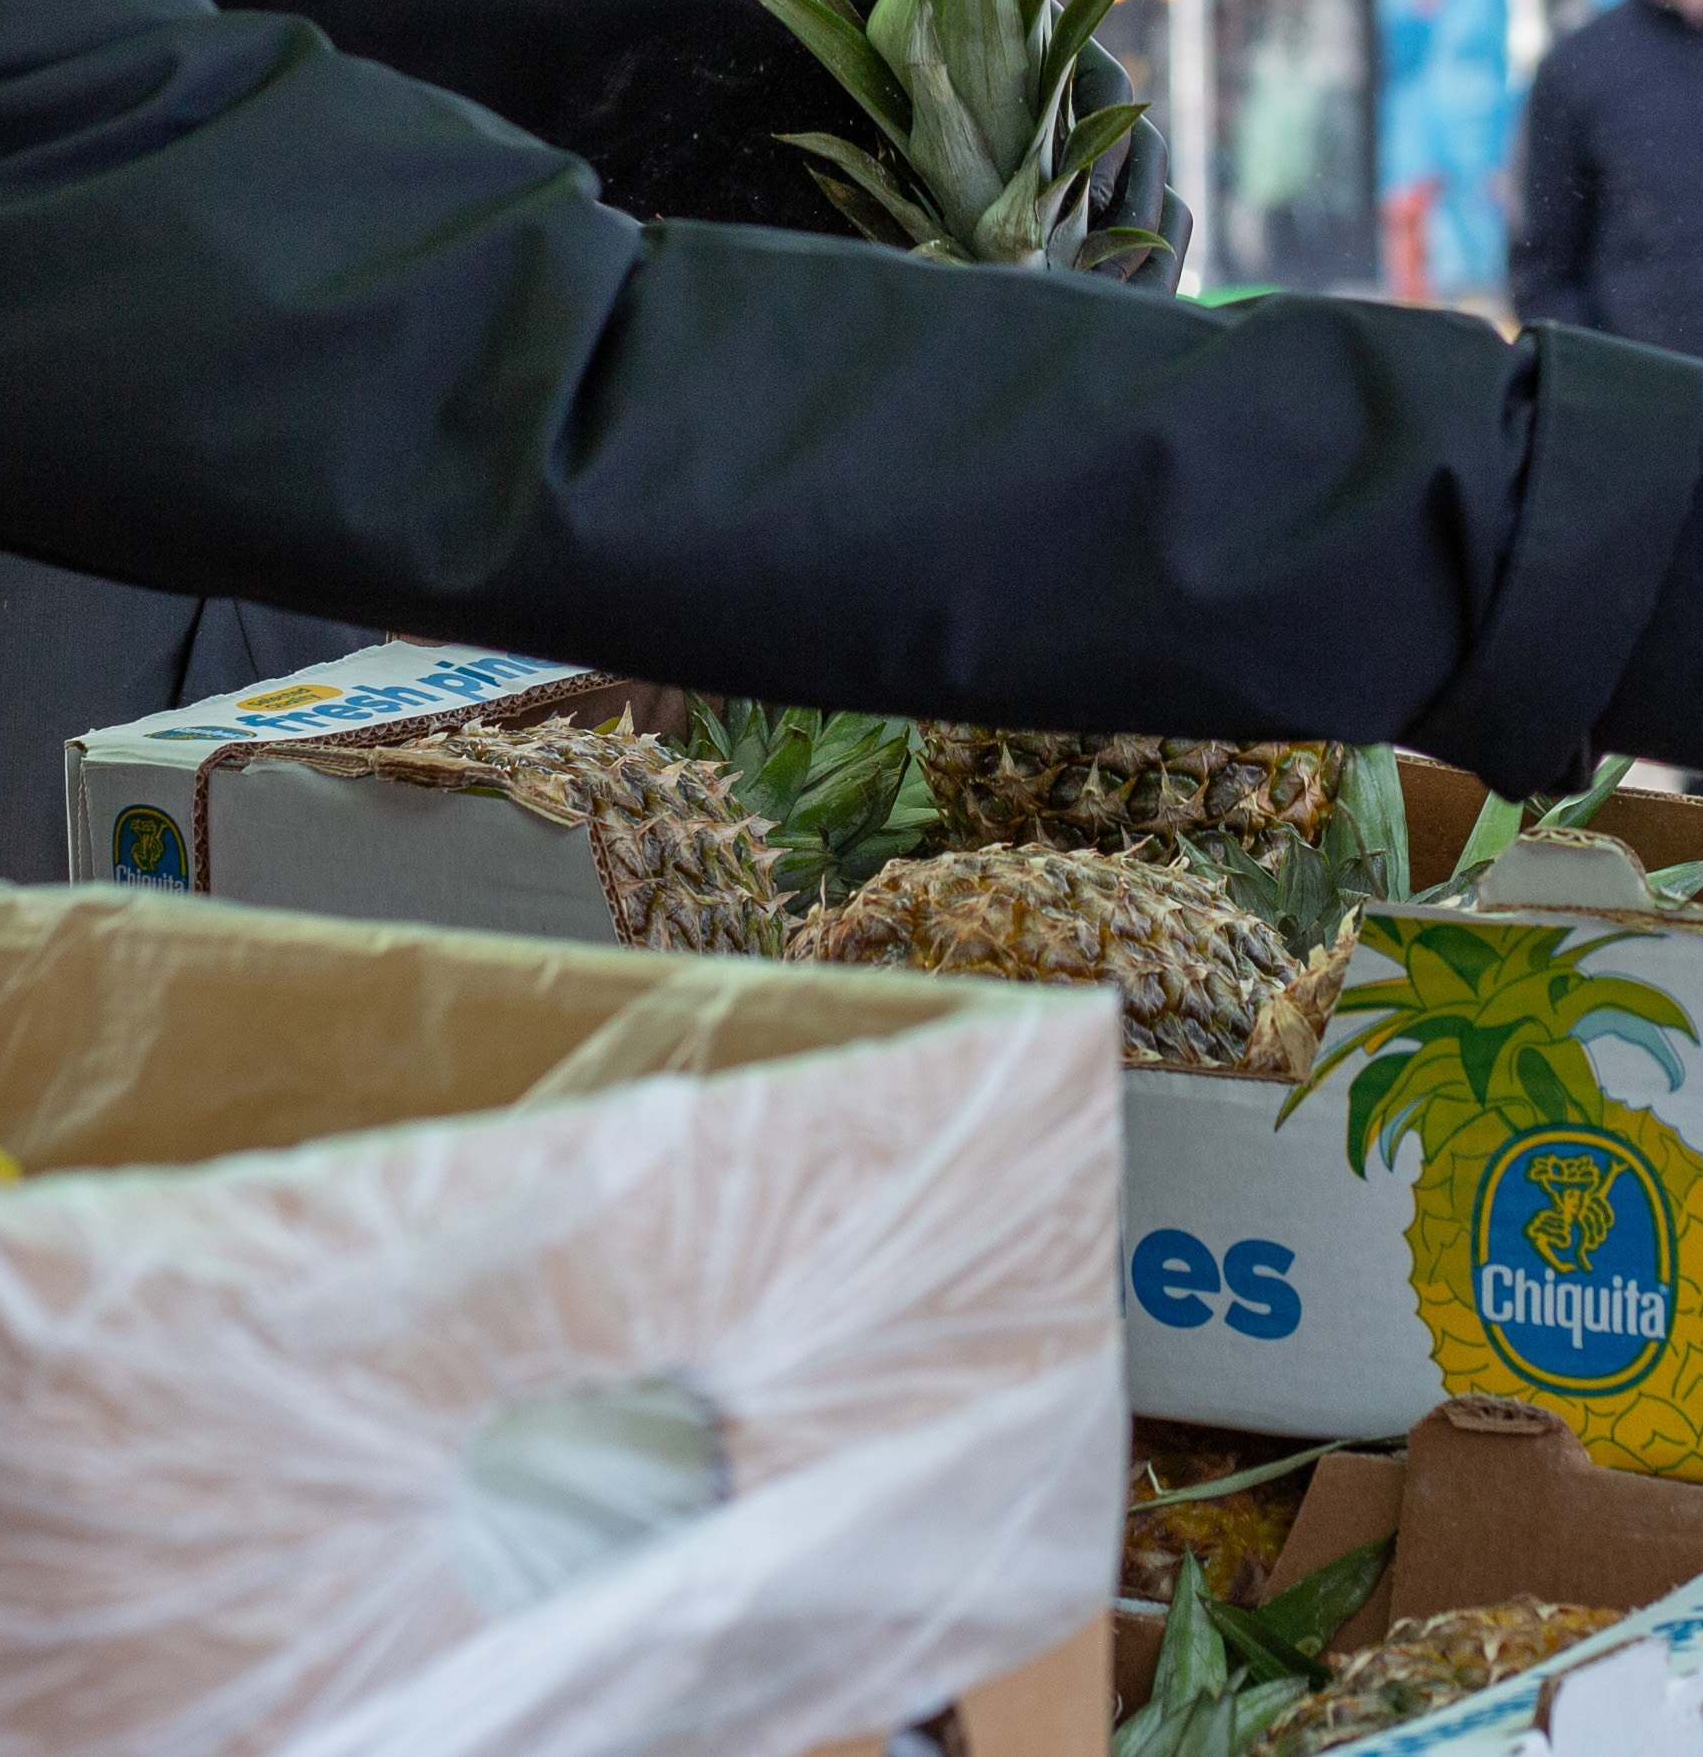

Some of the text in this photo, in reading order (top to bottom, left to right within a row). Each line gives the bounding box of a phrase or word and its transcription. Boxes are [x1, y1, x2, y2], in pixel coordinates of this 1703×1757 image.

[235, 684, 443, 733] fresh
[1120, 1218, 1302, 1340] es
[1480, 1264, 1666, 1349] Chiquita
